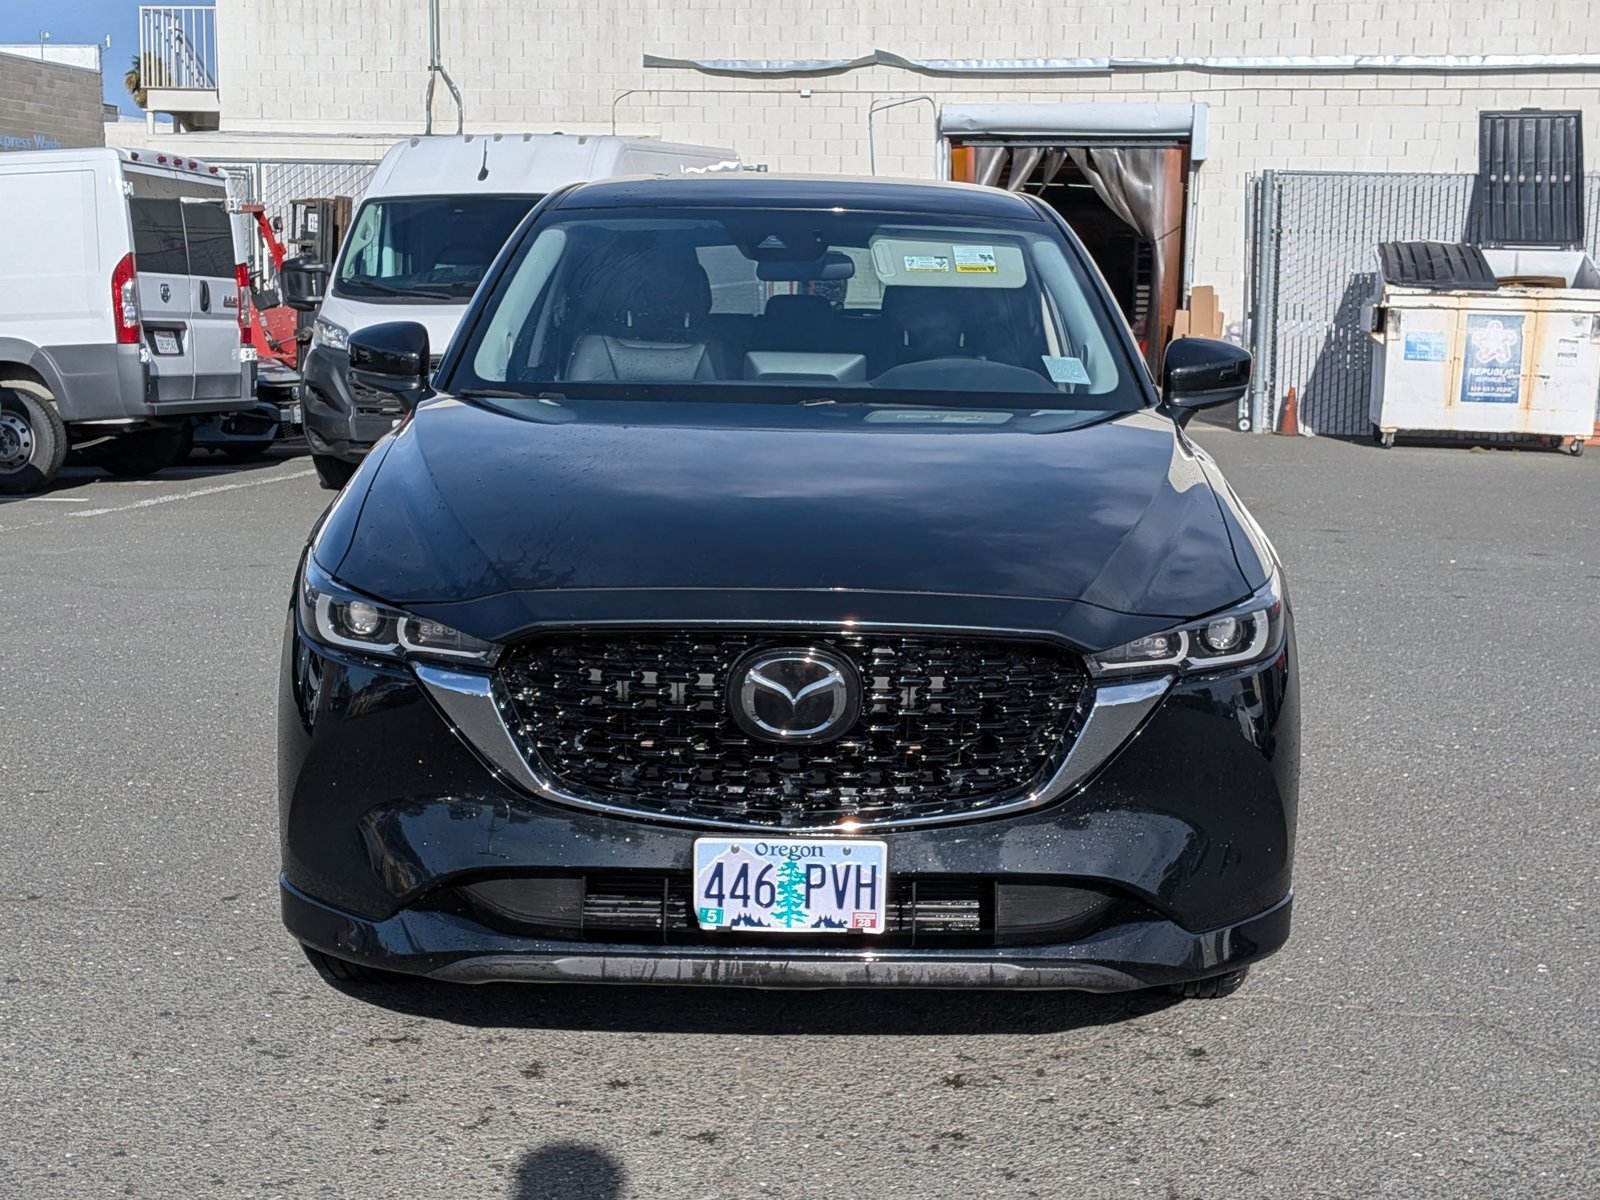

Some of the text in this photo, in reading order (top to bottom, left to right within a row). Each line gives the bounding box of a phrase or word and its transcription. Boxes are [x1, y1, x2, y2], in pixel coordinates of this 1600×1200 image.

[1468, 367, 1515, 377] REPUBLIC
[754, 842, 825, 861] Oregon
[705, 862, 877, 910] 446 PVH
[706, 910, 717, 922] 5
[857, 918, 871, 927] 28
